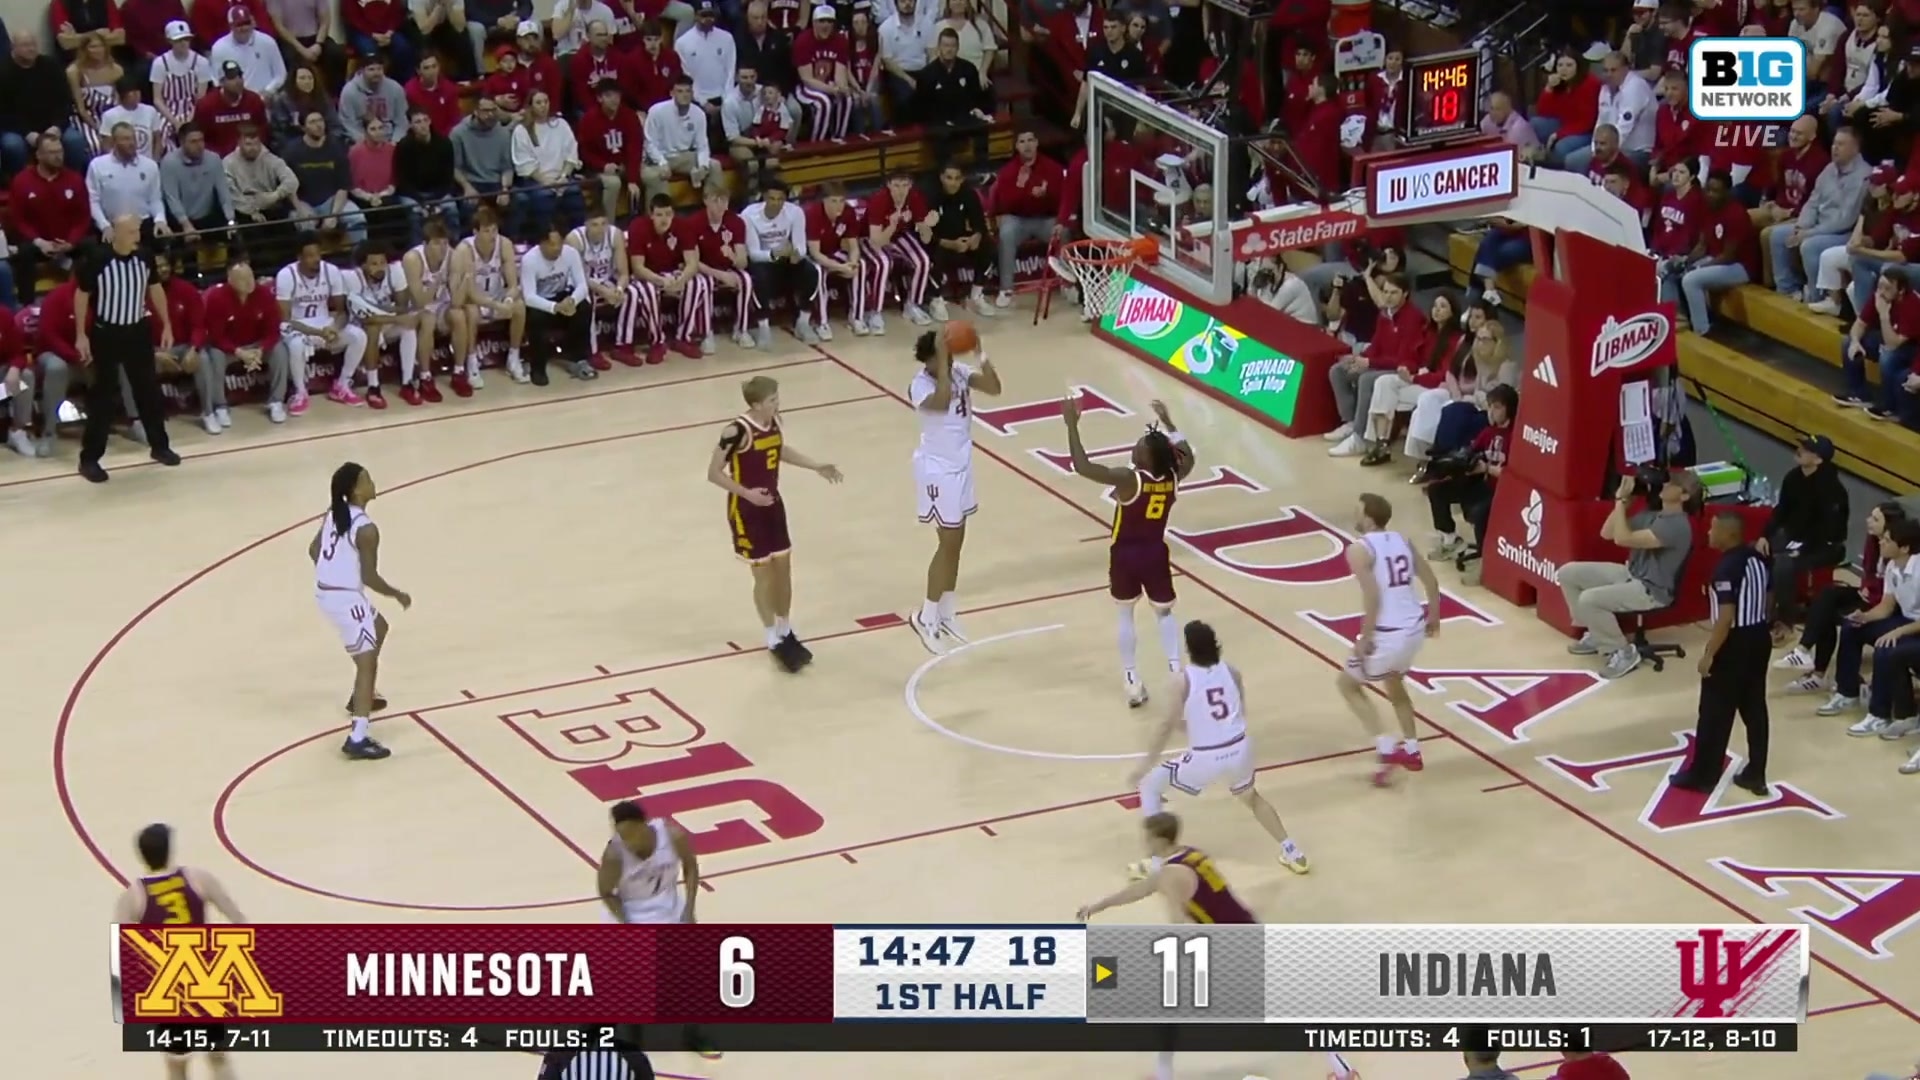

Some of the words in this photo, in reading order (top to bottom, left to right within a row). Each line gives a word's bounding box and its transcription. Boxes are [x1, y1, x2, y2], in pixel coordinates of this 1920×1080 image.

[1423, 64, 1468, 91] 14:46
[1434, 91, 1458, 121] 18
[1389, 177, 1407, 203] IU
[1411, 172, 1430, 199] VS
[1433, 162, 1500, 195] CANCER
[1115, 292, 1178, 328] LIBMAN
[1595, 321, 1660, 368] LIBMAN
[1239, 358, 1296, 380] TORNADO
[1240, 376, 1263, 395] Spin
[1263, 375, 1286, 393] Mop
[1523, 424, 1559, 454] meijer
[766, 448, 777, 470] 2
[1145, 494, 1167, 519] 6
[1385, 554, 1412, 588] 12
[1205, 686, 1231, 722] 5
[155, 891, 192, 924] 3
